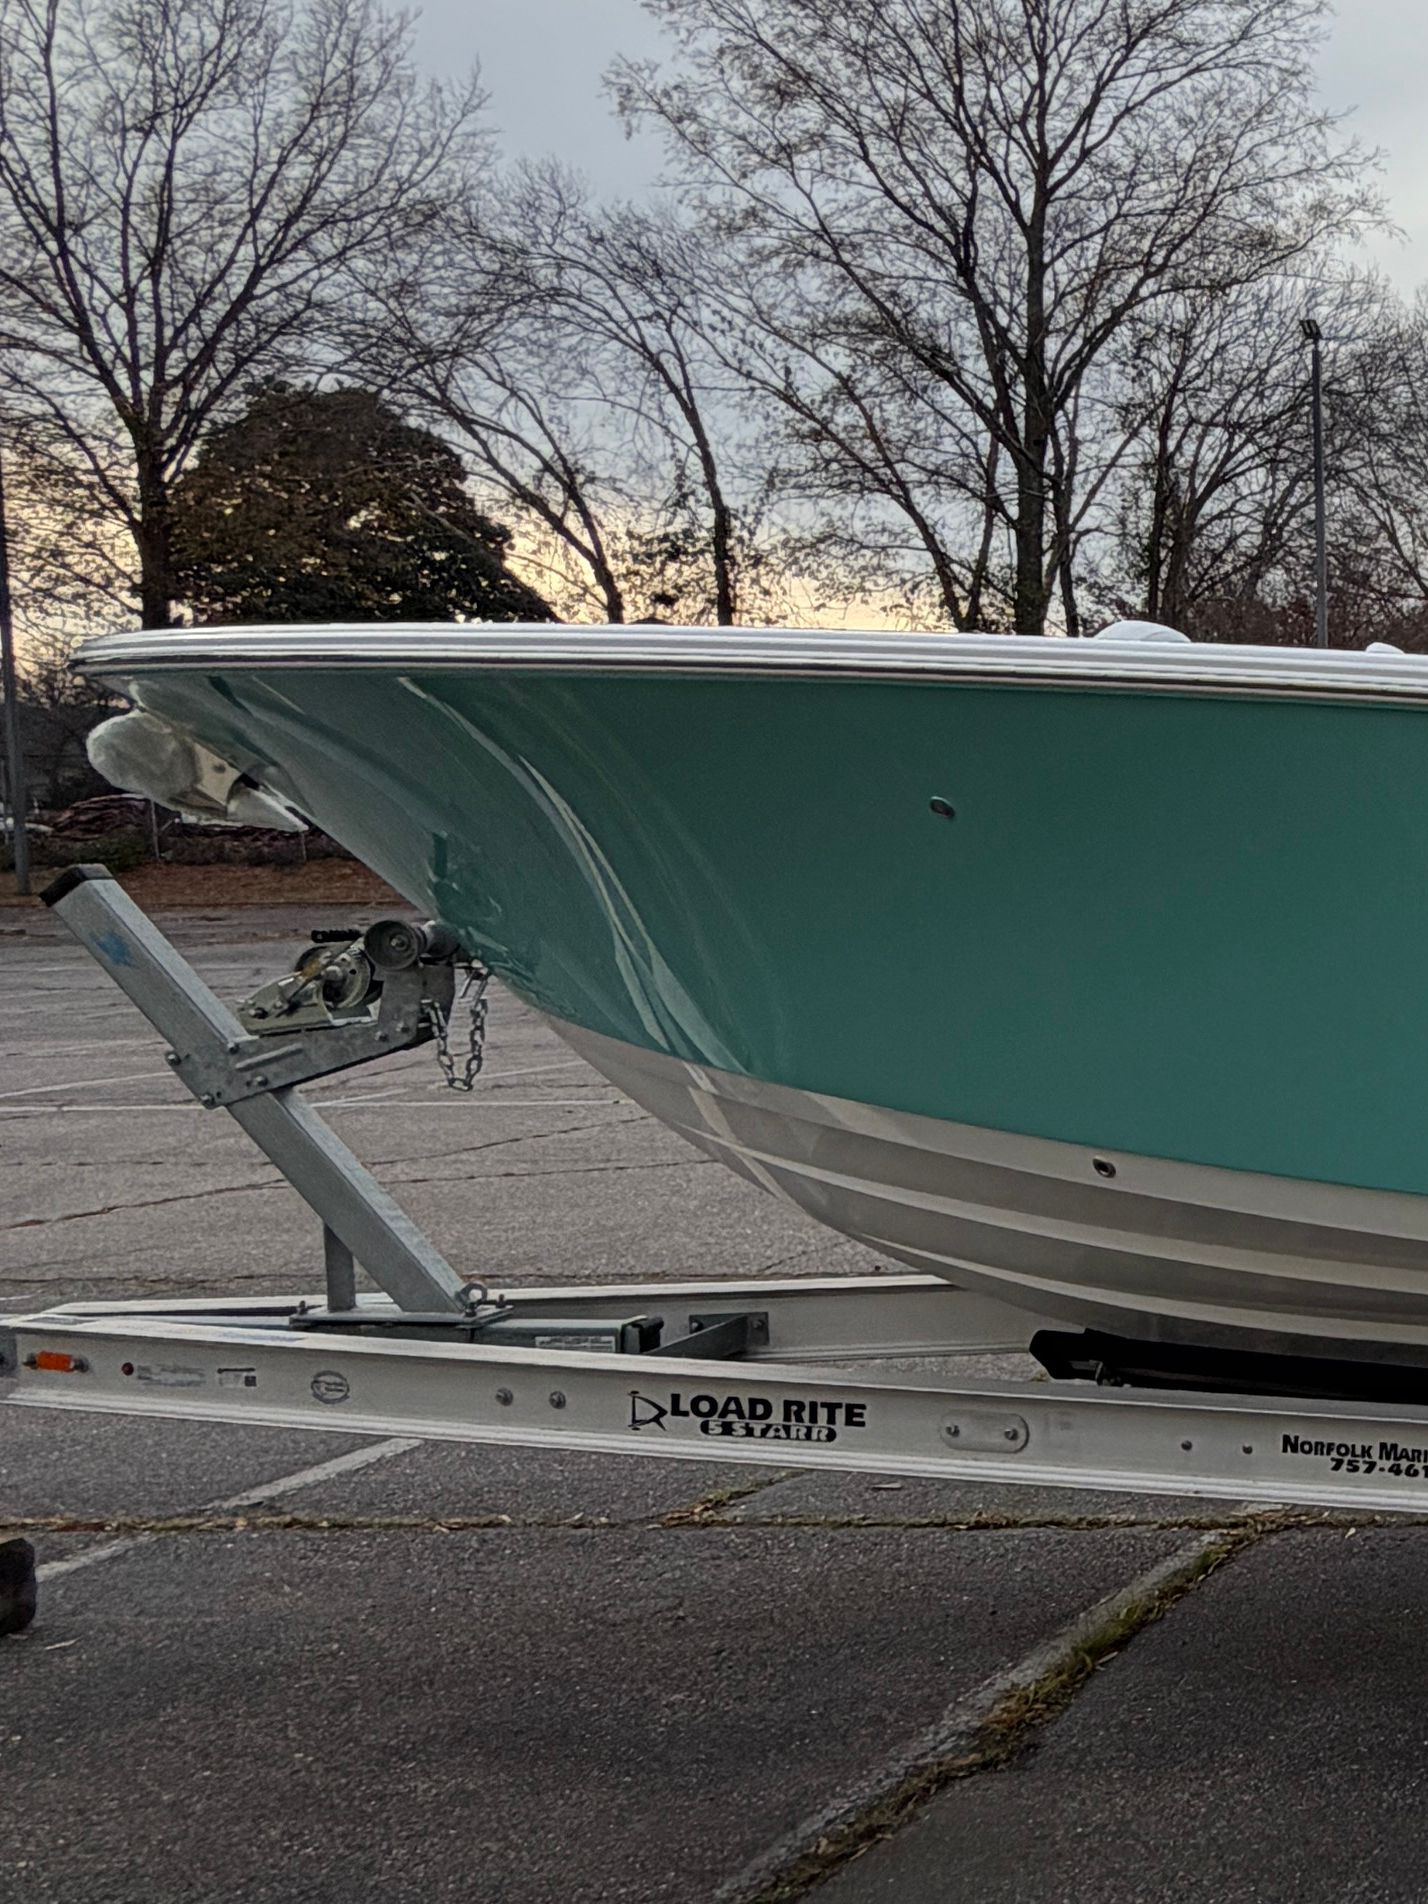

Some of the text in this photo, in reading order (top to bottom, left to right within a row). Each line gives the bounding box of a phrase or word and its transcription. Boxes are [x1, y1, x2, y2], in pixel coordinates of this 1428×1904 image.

[670, 1393, 867, 1428] LOAD RITE
[707, 1419, 830, 1444] 5 STARR
[1281, 1434, 1373, 1459] NORFOLK
